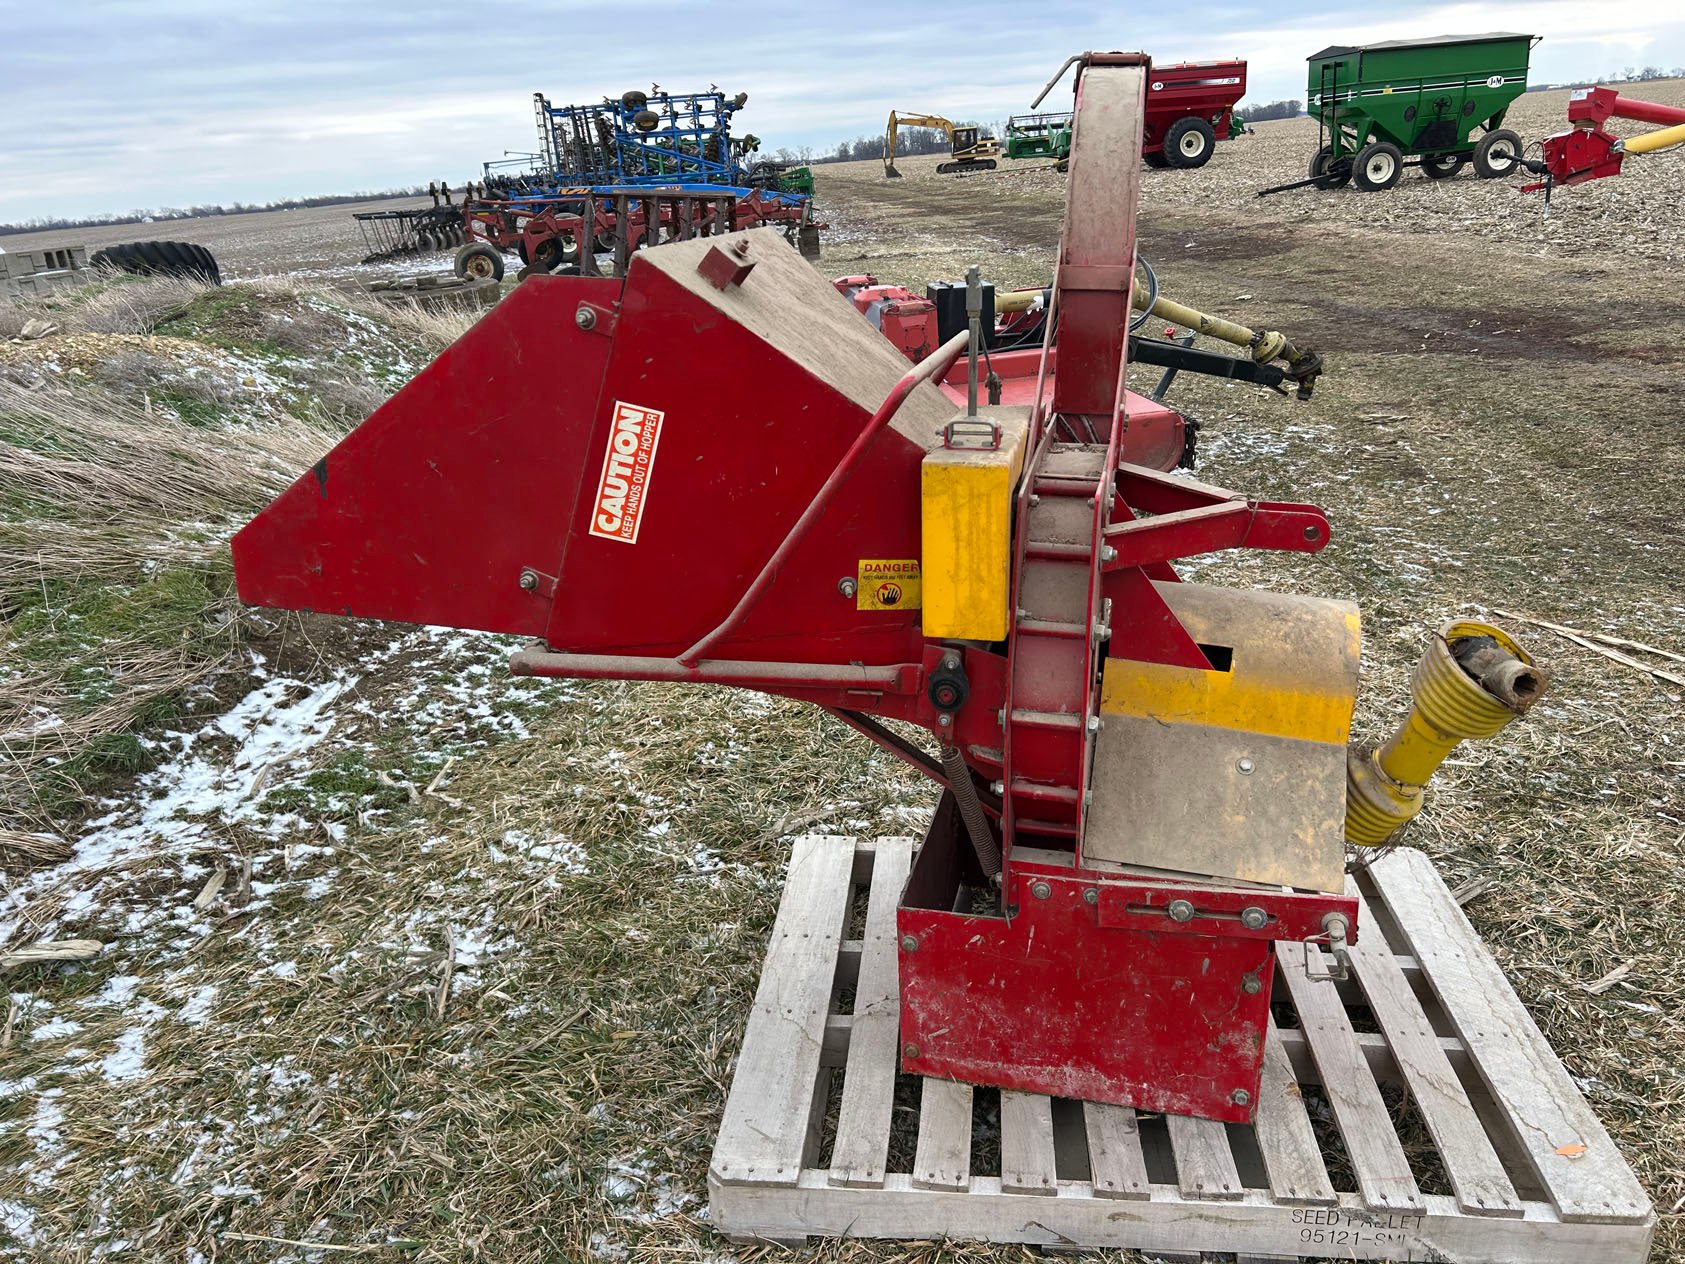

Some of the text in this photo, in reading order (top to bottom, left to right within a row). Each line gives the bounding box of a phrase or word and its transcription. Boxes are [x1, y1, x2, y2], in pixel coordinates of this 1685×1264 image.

[597, 408, 644, 532] CAUTION
[621, 413, 658, 538] KEEP HANDS OUT OF HOPPER
[864, 563, 918, 573] DANGER
[1292, 1208, 1340, 1226] SEED
